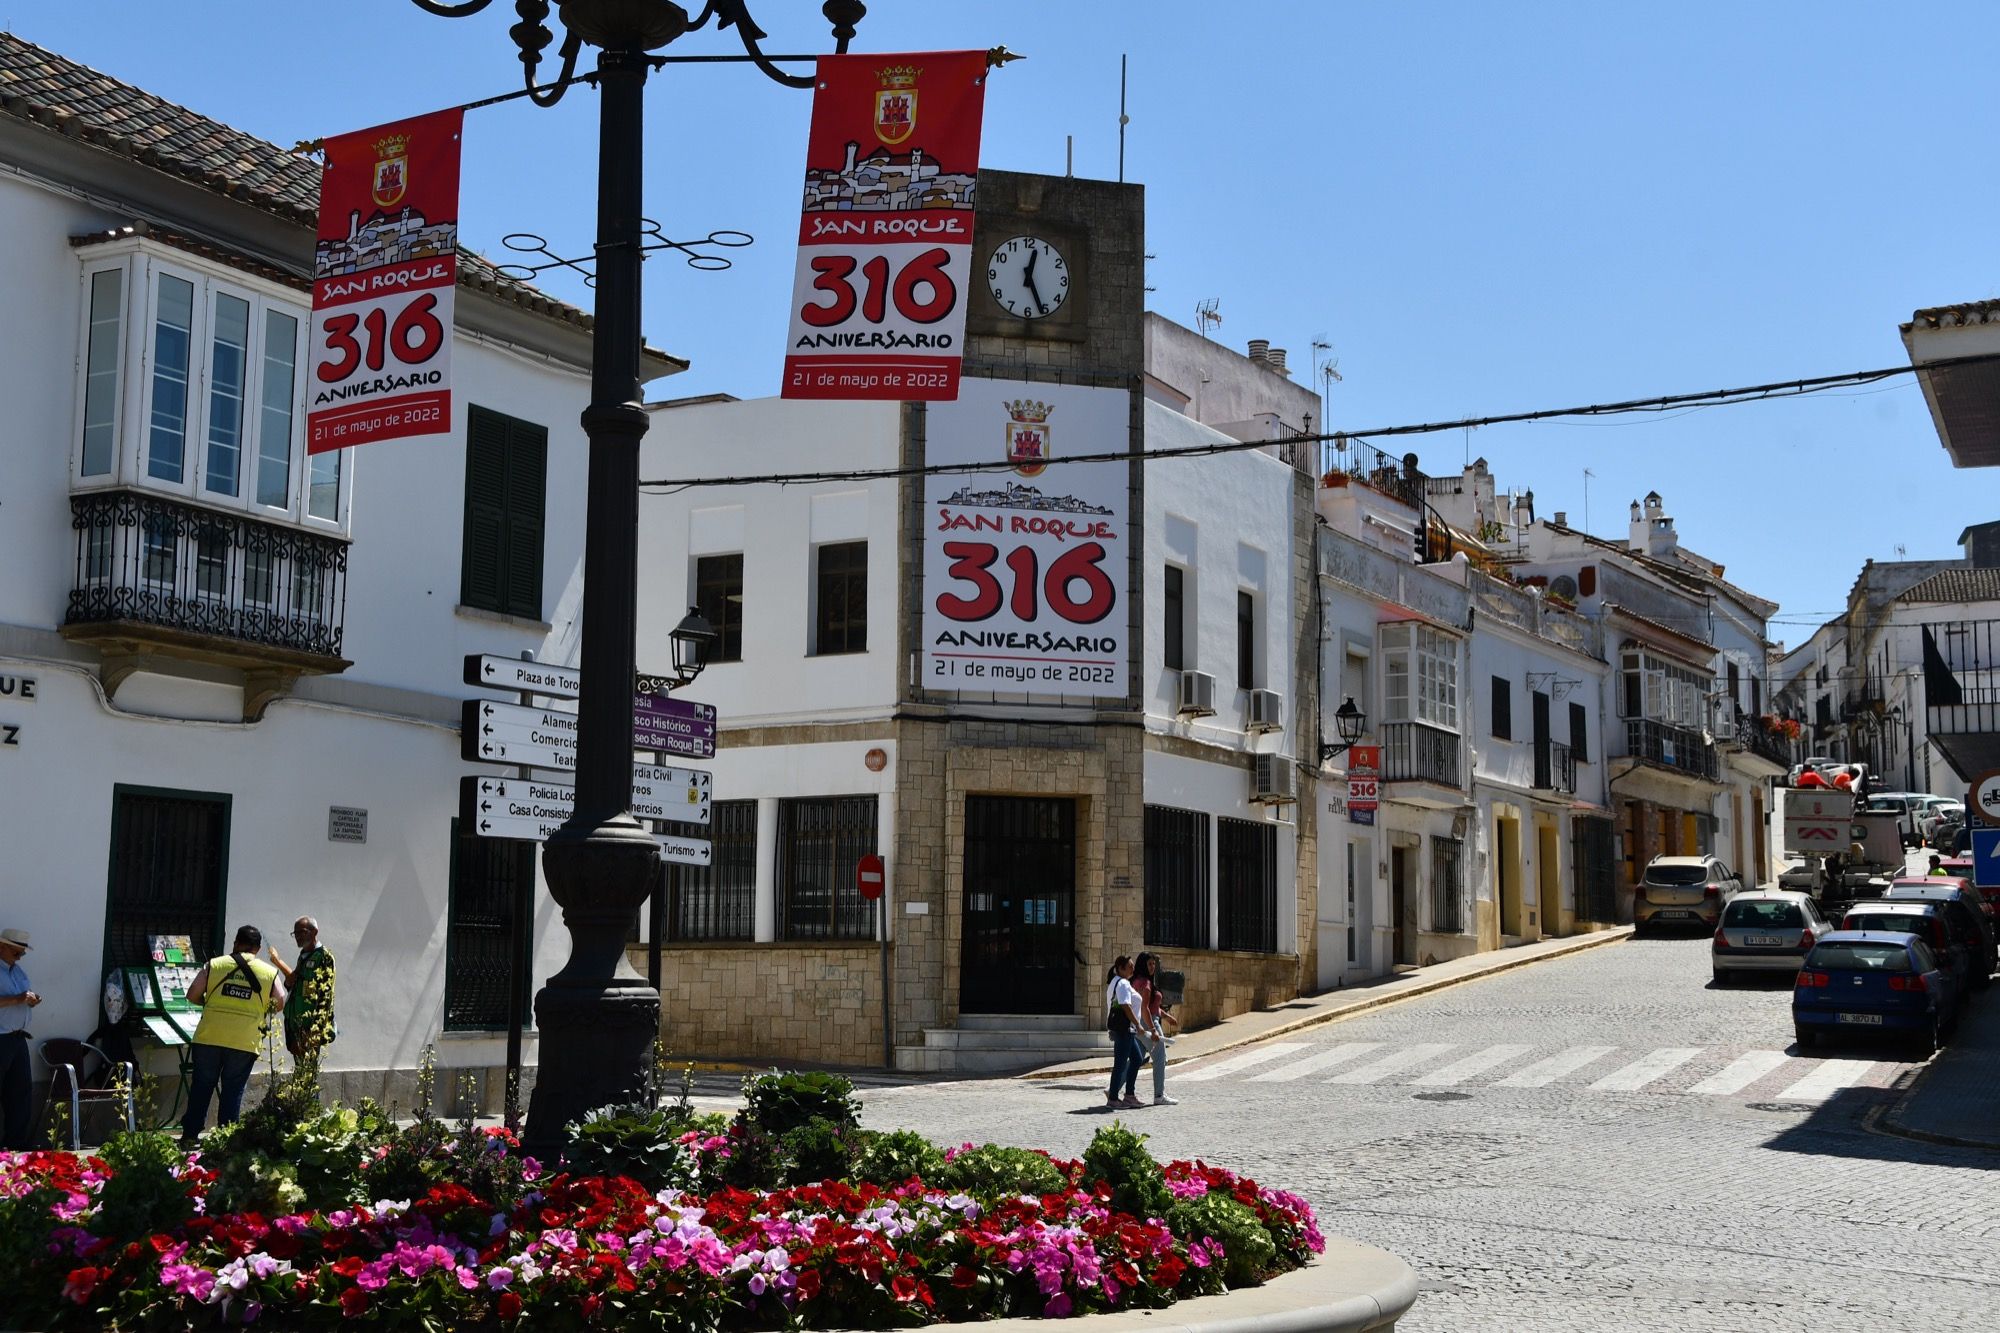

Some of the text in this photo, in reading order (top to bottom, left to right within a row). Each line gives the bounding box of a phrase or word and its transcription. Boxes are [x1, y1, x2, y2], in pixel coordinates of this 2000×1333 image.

[811, 217, 965, 238] SAN ROQUE
[1007, 241, 1017, 252] 11
[1022, 238, 1036, 249] 12
[1044, 245, 1049, 256] 1
[995, 252, 1007, 264] 10
[1055, 258, 1063, 269] 2
[989, 269, 997, 280] 9
[323, 264, 448, 301] SAN ROQUE
[801, 247, 957, 327] 316
[1060, 276, 1067, 287] 3
[995, 288, 1002, 299] 8
[1053, 293, 1061, 304] 4
[1007, 300, 1015, 311] 7
[1024, 306, 1032, 317] 6
[1042, 303, 1049, 314] 5
[317, 293, 444, 383] 316
[796, 330, 952, 350] ANIVERSARIO
[793, 373, 948, 388] 21 de mayo de 2022
[315, 370, 441, 405] ANIVERSARIO
[315, 407, 440, 440] 21 de mayo de 2022
[938, 508, 1117, 542] SAN ROQUE
[936, 541, 1116, 624] 316
[936, 630, 1117, 653] ANIVERSARIO
[935, 660, 1114, 683] 21 de mayo de 2022
[517, 669, 580, 690] Plaza de Toro
[634, 696, 652, 708] esia
[542, 714, 578, 730] Alame
[634, 716, 691, 733] sco Histórico
[2, 725, 20, 745] Z
[531, 731, 577, 749] Comercio
[634, 733, 693, 752] seo San Roque
[634, 768, 672, 782] rdia Civil
[560, 789, 575, 801] Loc
[632, 785, 652, 795] reos
[1350, 783, 1376, 796] 316
[1333, 796, 1343, 804] SAN
[509, 803, 531, 816] Casa
[632, 803, 663, 815] ercios
[663, 842, 695, 857] Turismo
[229, 989, 251, 999] ONCE
